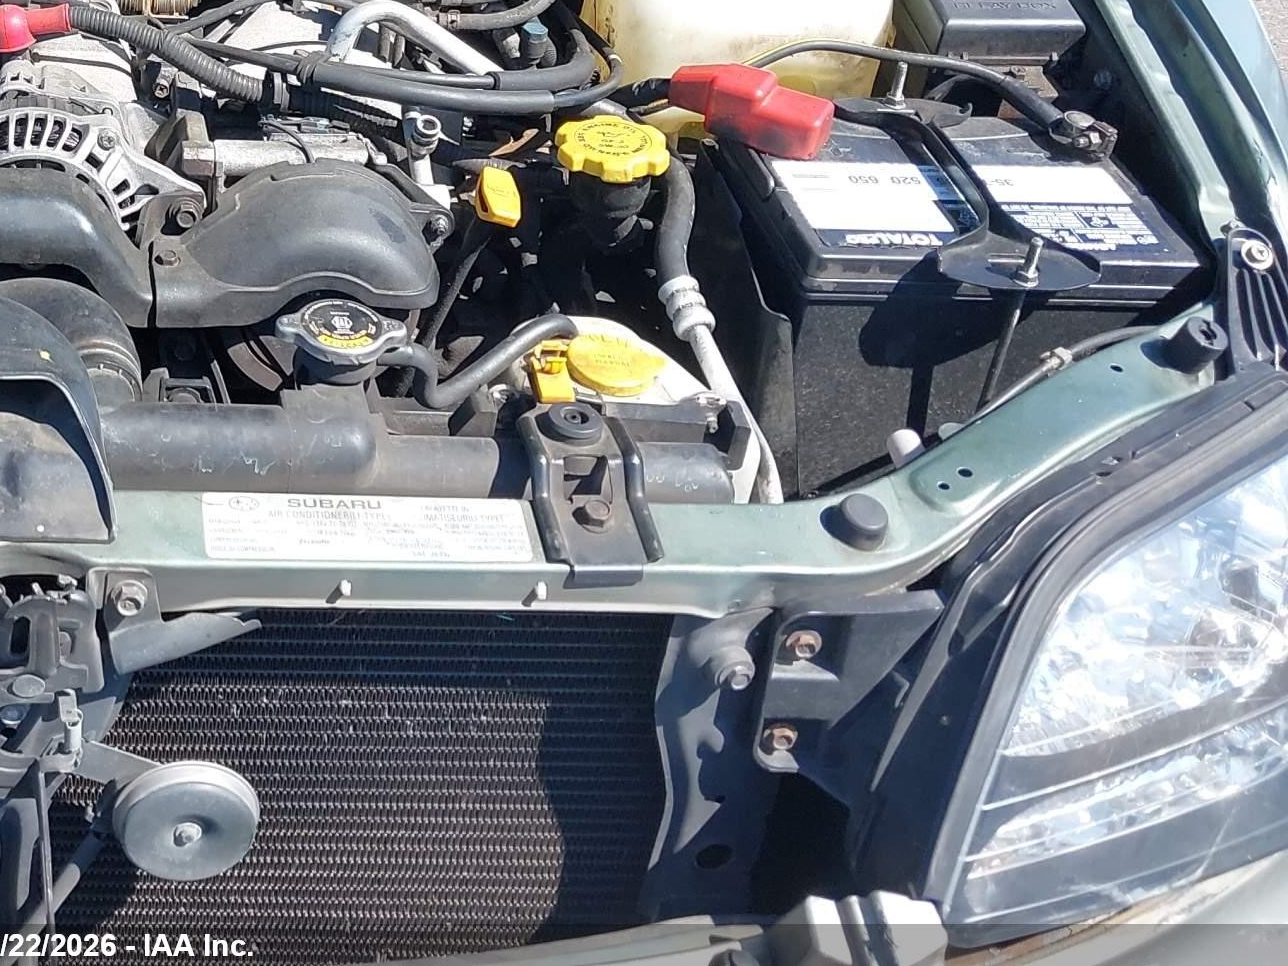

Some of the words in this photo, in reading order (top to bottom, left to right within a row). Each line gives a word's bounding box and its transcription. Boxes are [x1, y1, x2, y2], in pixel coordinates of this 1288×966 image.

[848, 175, 879, 184] 650
[890, 176, 921, 185] 520
[287, 497, 382, 510] SUBARU
